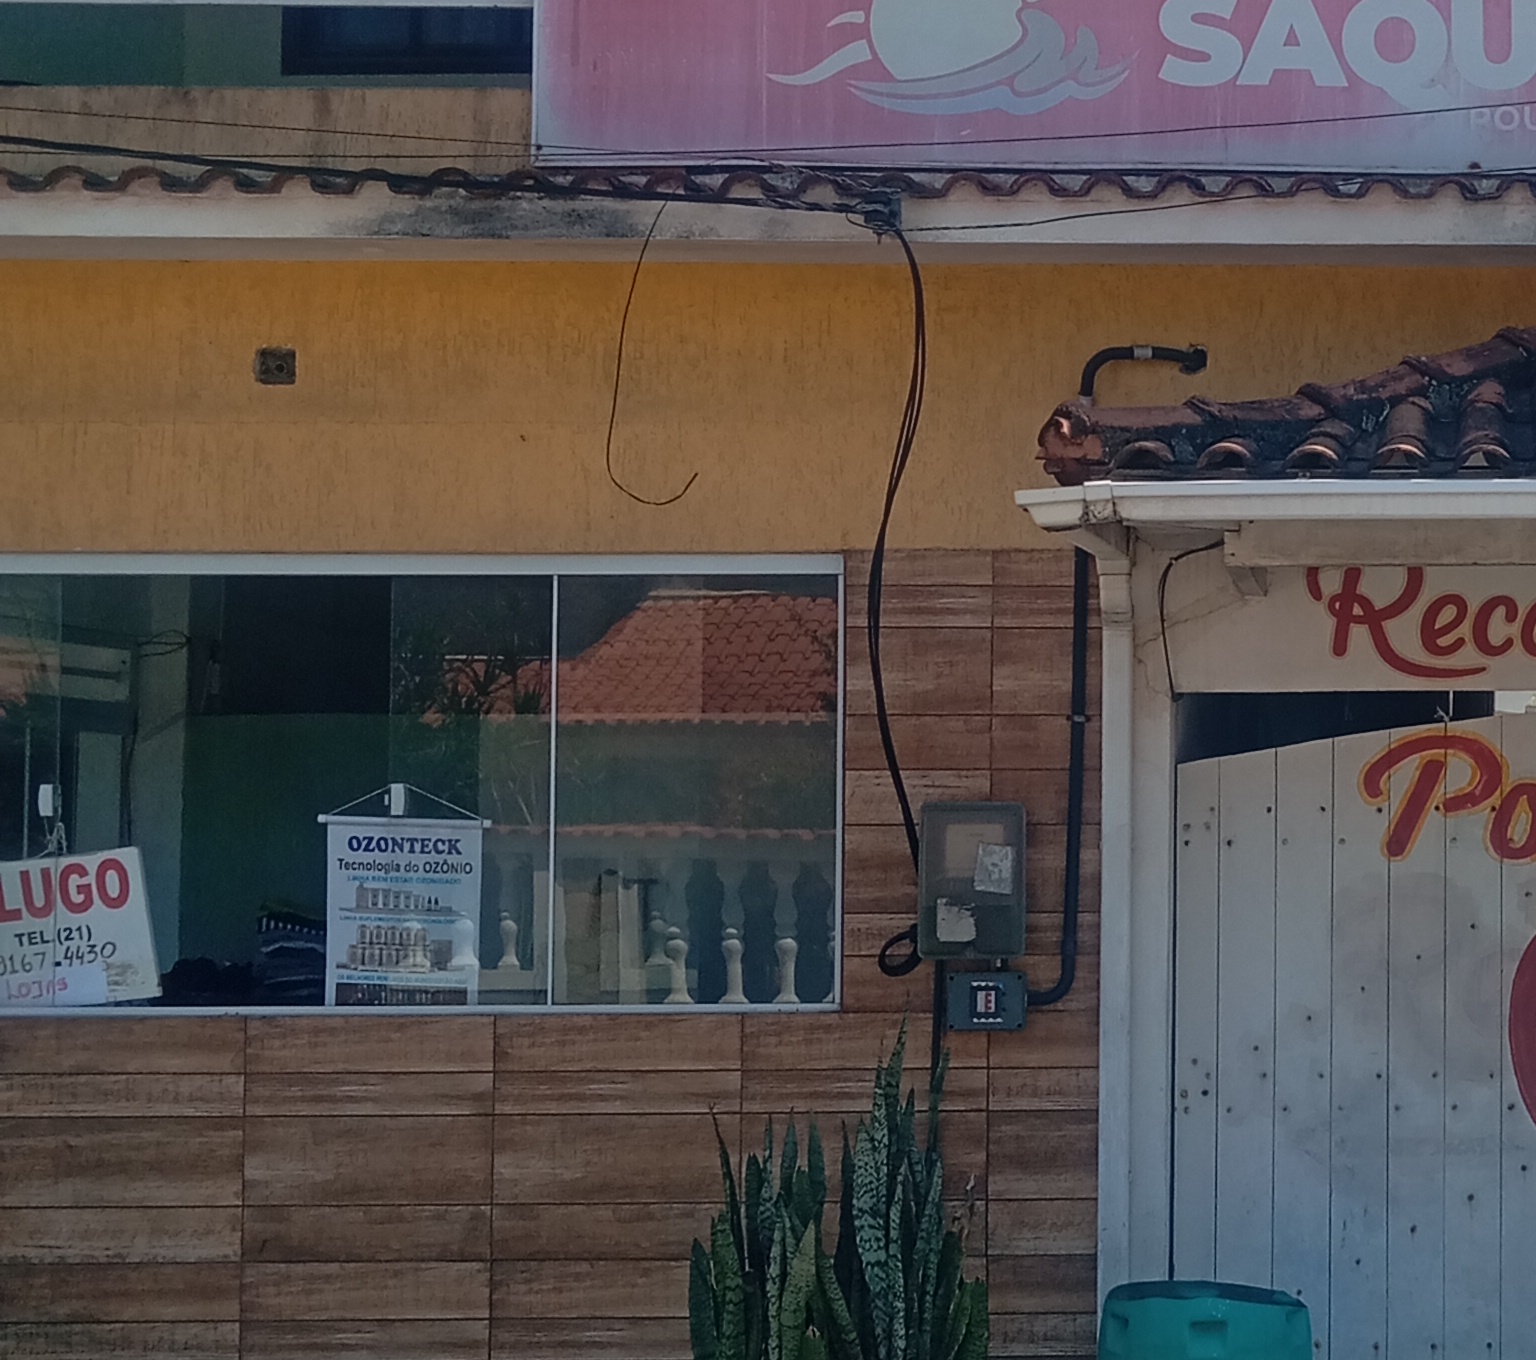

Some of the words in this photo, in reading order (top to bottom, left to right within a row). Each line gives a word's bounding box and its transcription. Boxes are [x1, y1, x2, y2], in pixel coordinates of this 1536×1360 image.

[348, 835, 463, 856] OZONTECK
[337, 858, 400, 875] Tecnologia
[404, 860, 420, 873] do
[423, 859, 473, 875] OZÔNIO
